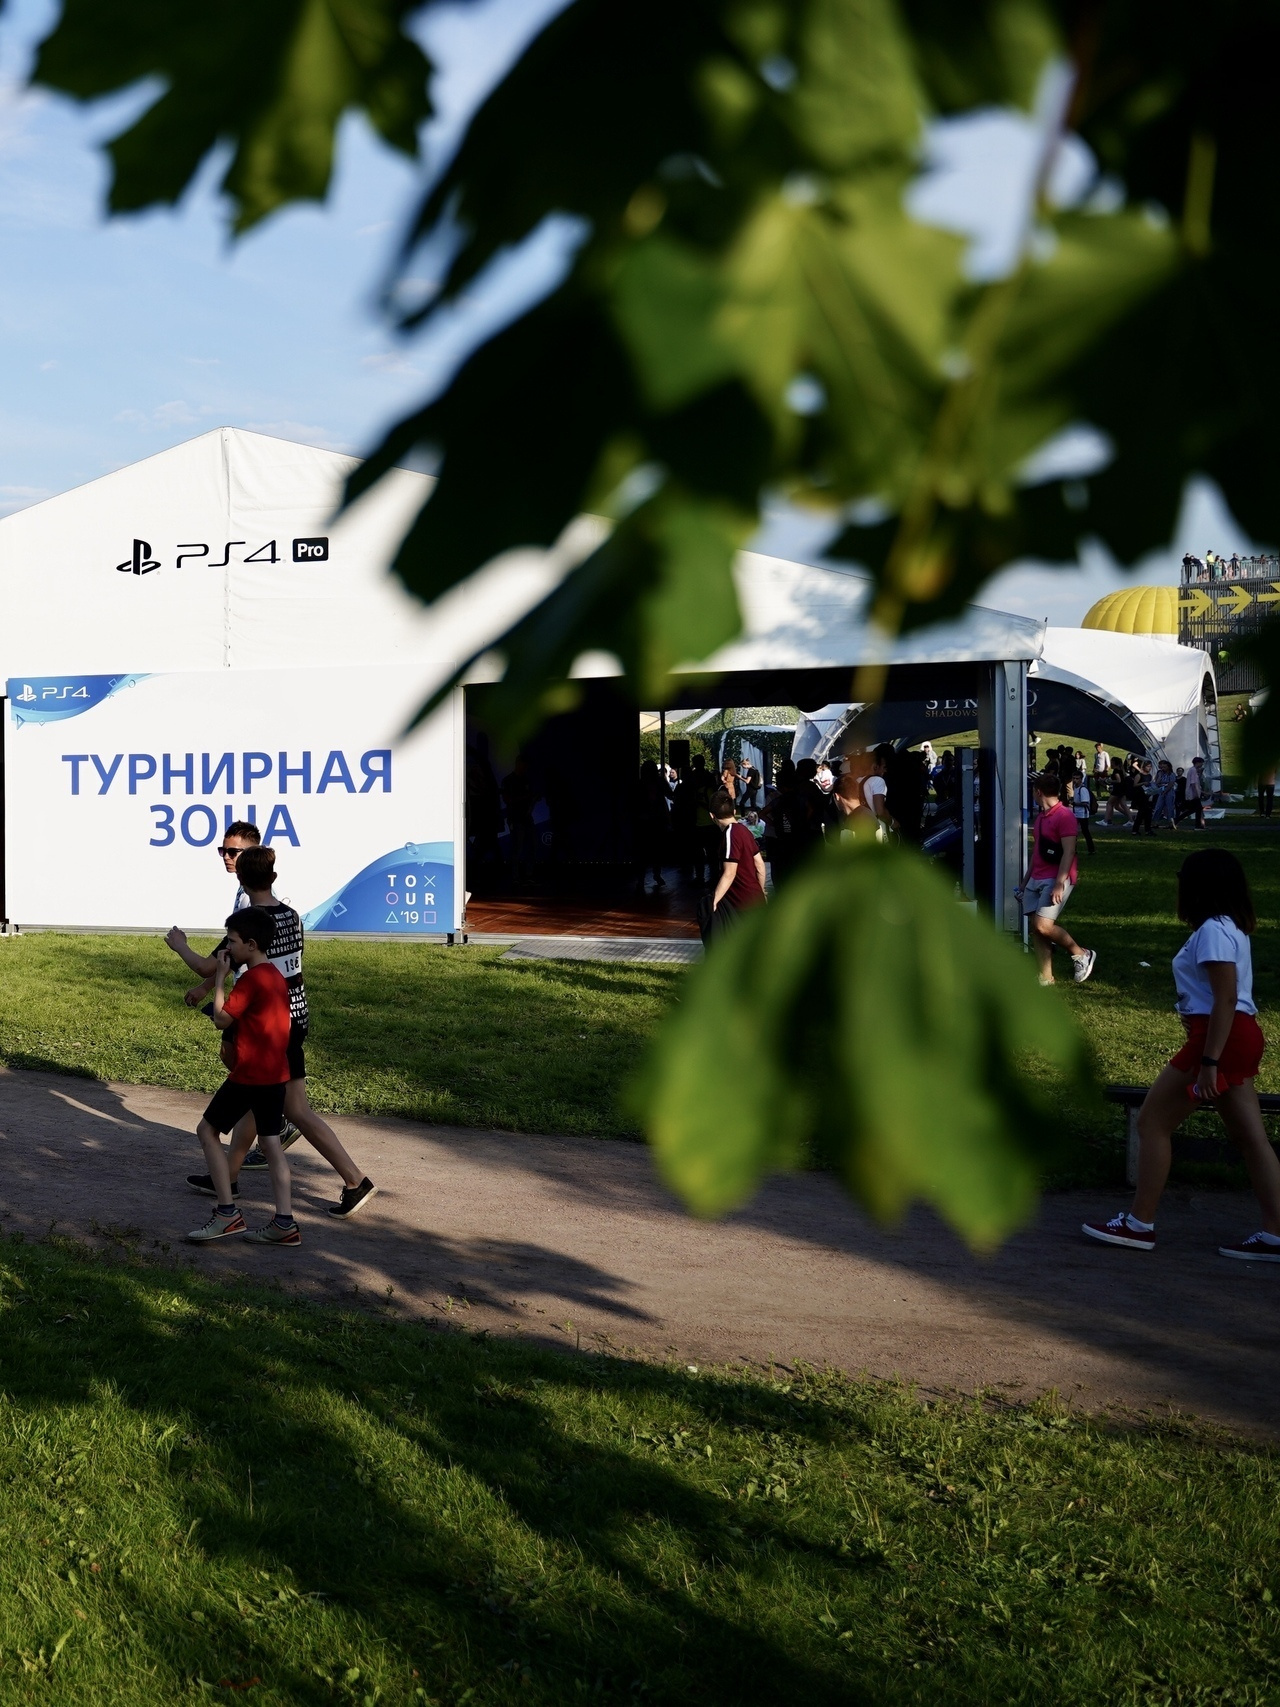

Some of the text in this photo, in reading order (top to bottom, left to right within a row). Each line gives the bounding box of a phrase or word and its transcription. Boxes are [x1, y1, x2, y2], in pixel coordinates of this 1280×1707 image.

[177, 540, 324, 568] PS4 Pro
[42, 686, 88, 699] PS4
[925, 710, 978, 718] SHADOWS
[61, 749, 392, 795] ТУРНИРНАЯ
